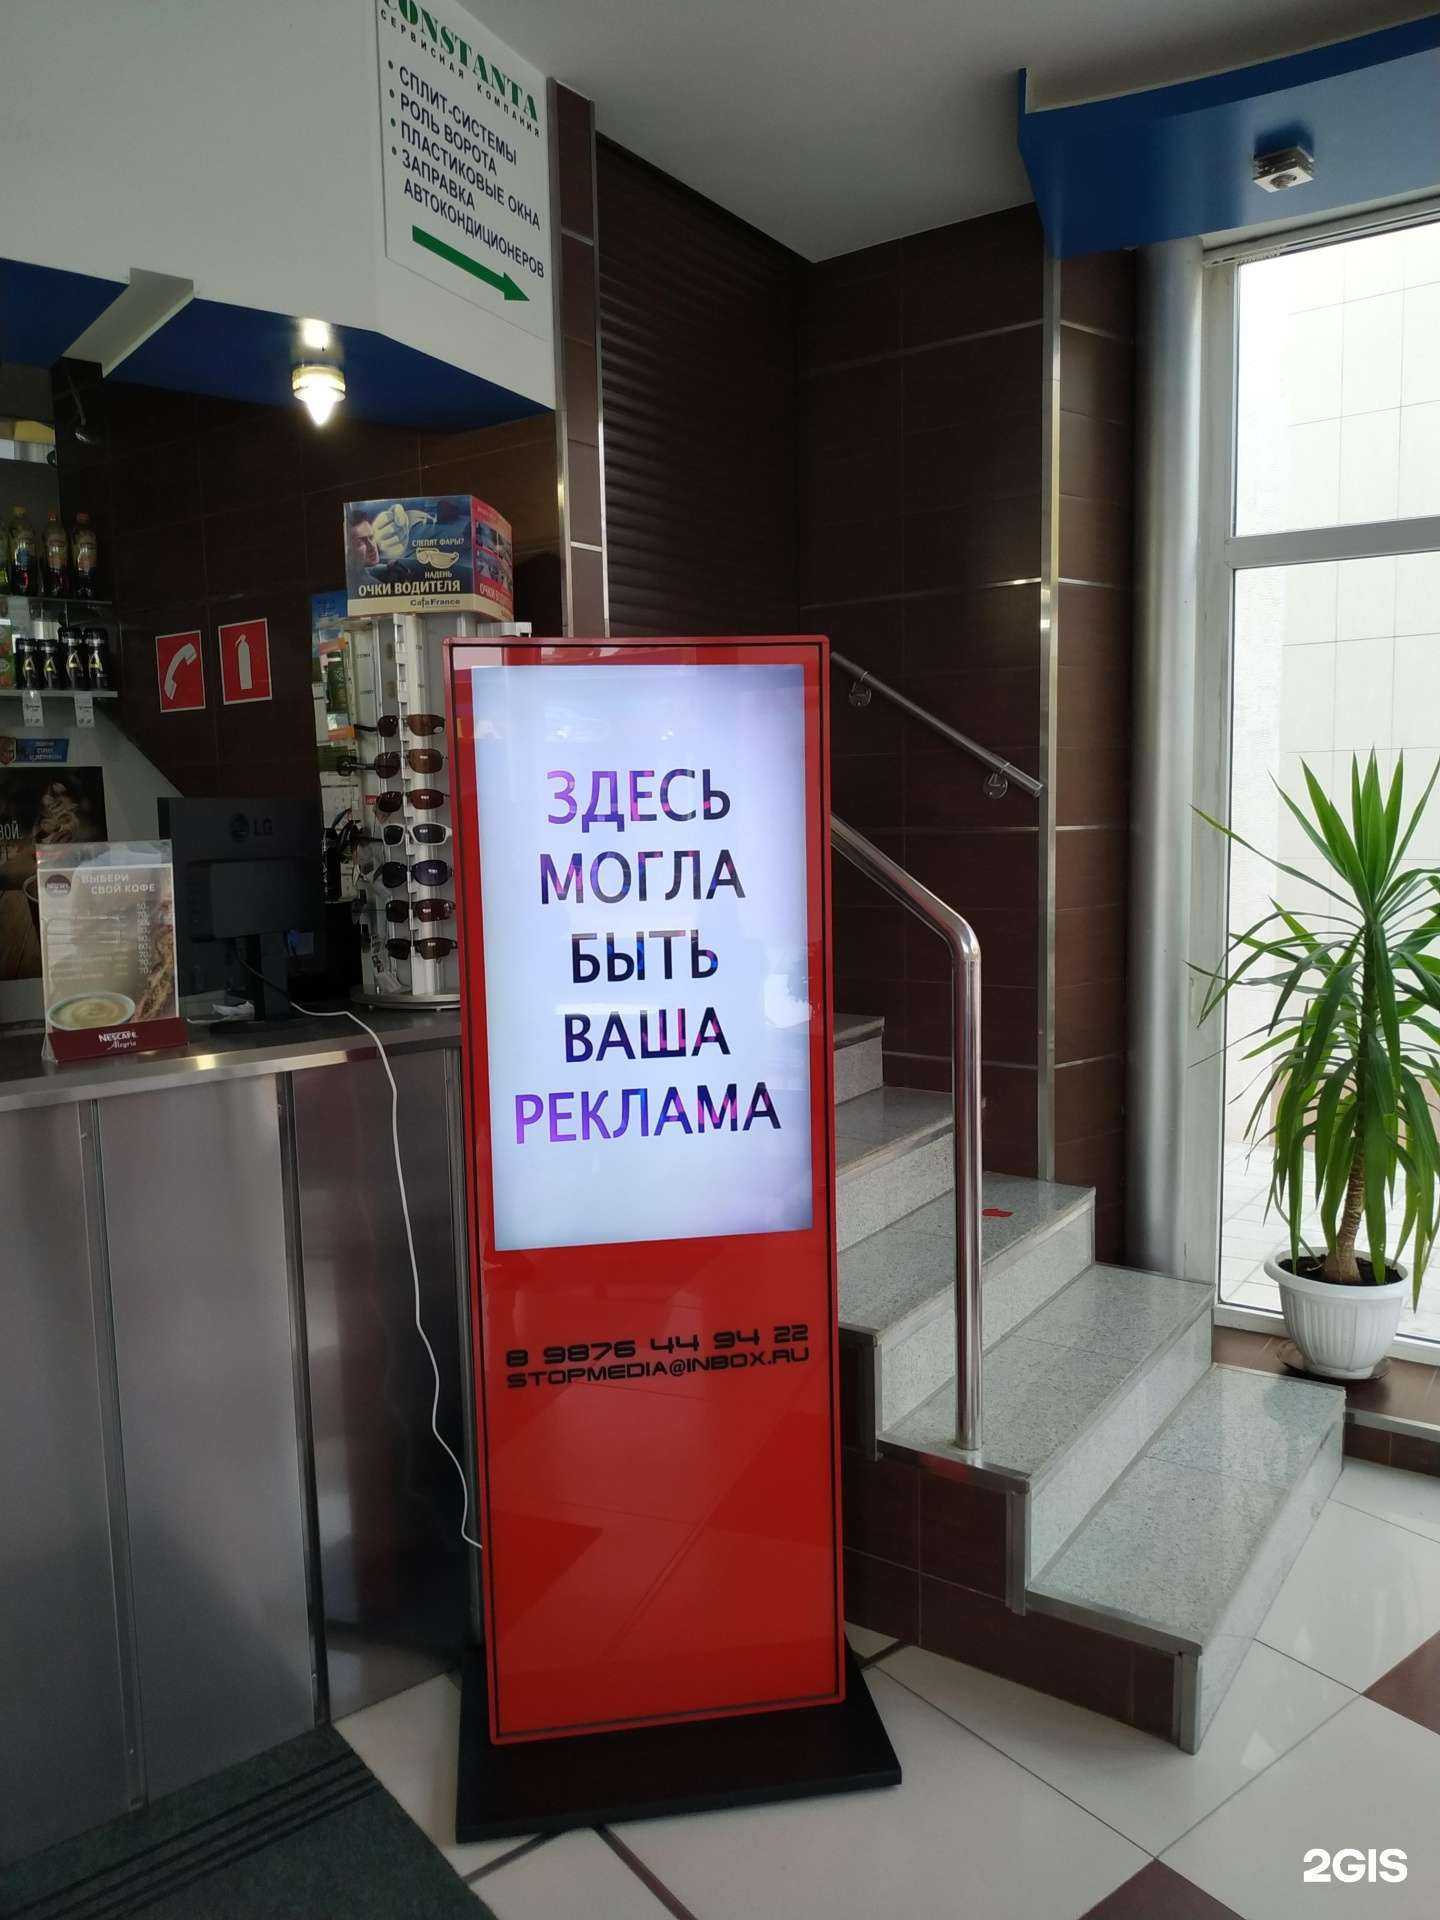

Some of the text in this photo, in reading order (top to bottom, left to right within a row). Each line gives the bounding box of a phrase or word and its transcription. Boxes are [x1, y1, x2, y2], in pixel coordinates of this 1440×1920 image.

[380, 9, 540, 138] СЕРВИСНАЯ КОМПАНИЯ
[399, 66, 518, 166] СПЛИТ-СИСТЕМЫ
[400, 93, 498, 176] РОЛЬ ВОРОТА
[401, 122, 541, 231] ПЛАСТИКОВЫЕ ОКНА
[402, 149, 476, 211] ЗАПРАВКА
[403, 178, 545, 279] АВТОКОНДИЦИОНЕРОВ
[358, 579, 461, 597] ОЧКИ ВОДИТЕЛЯ
[546, 768, 731, 833] ЗДЕСЬ
[125, 883, 156, 893] КОФЕ
[539, 849, 746, 904] МОГЛА
[571, 929, 718, 984] БЫТЬ
[564, 1006, 731, 1063] ВАША
[514, 1081, 782, 1145] РЕКЛАМА
[506, 1323, 809, 1368] 8 9876 44 94 22
[506, 1347, 810, 1389] STOPMEDIA@INBOX.RU
